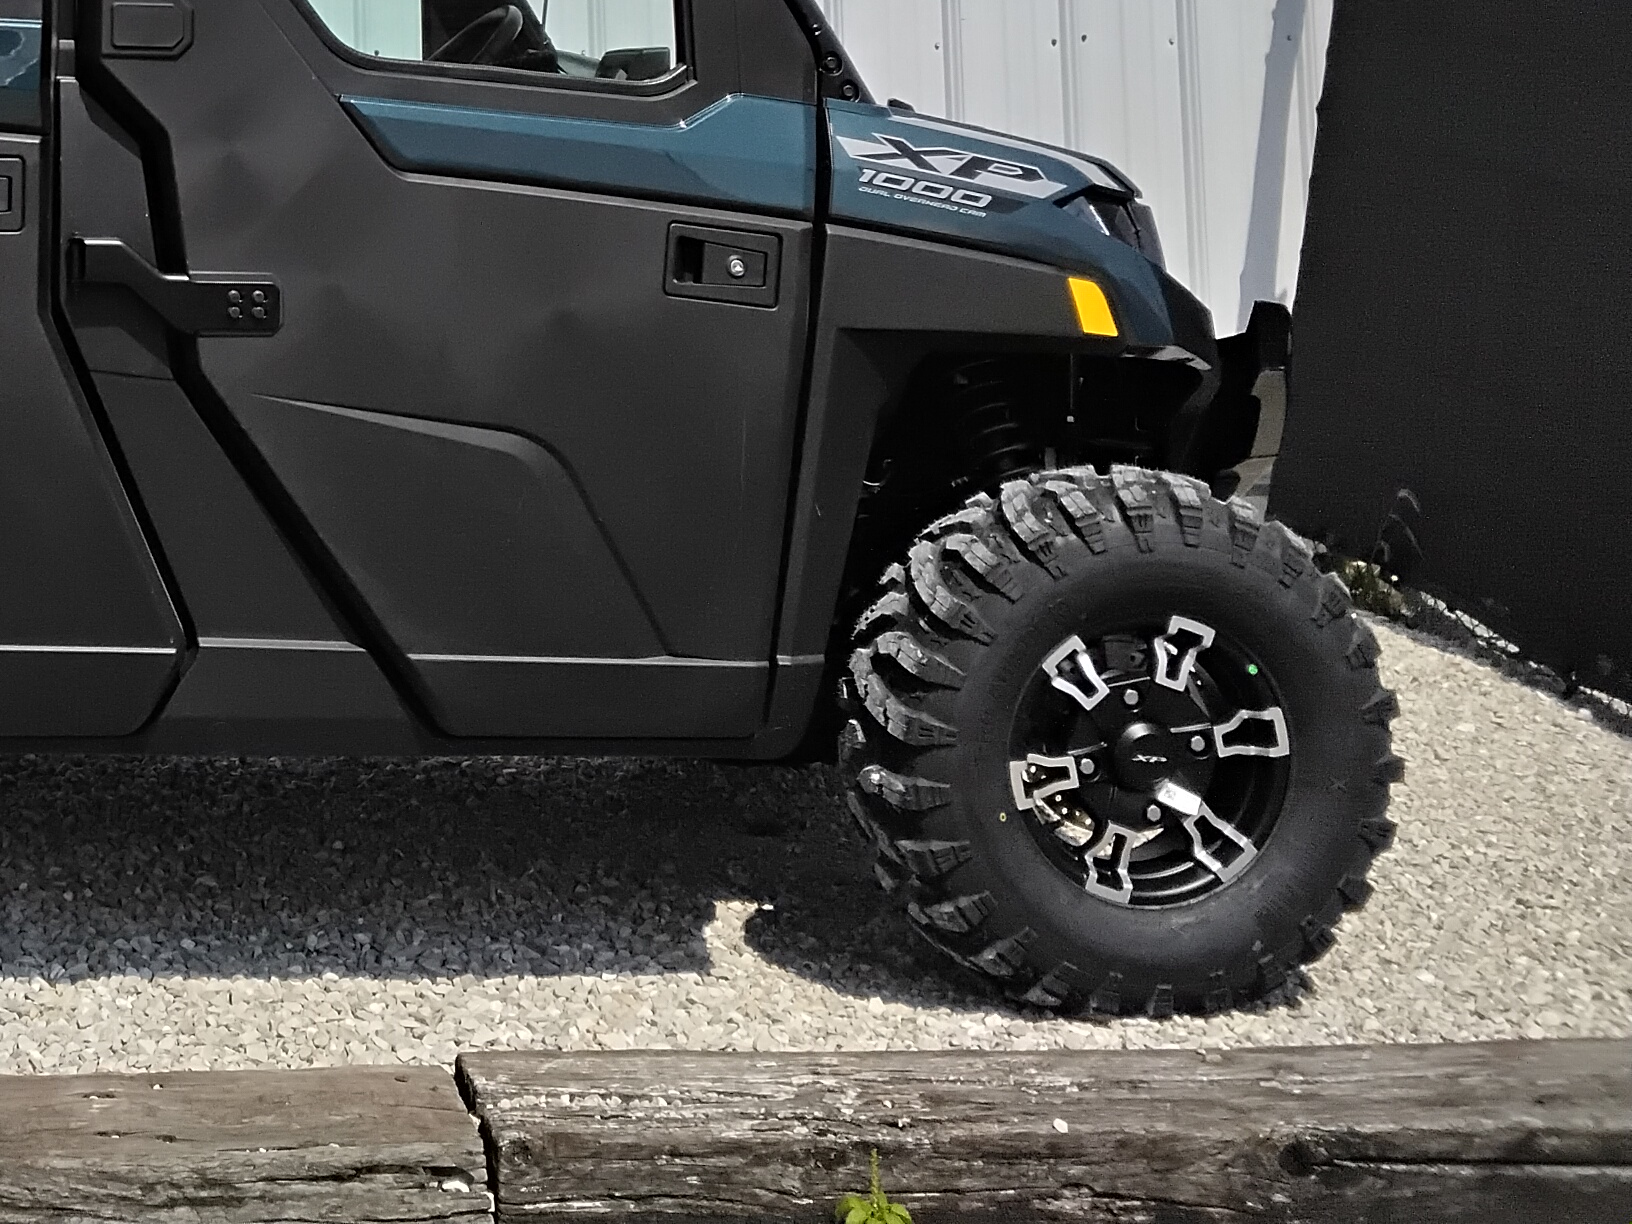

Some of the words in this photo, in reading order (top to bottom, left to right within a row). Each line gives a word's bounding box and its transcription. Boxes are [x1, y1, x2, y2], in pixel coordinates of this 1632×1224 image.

[851, 132, 1050, 183] XP
[858, 168, 992, 208] 1000
[858, 186, 891, 197] DUAL
[893, 193, 959, 211] OVERHEAD
[959, 207, 987, 218] CAM
